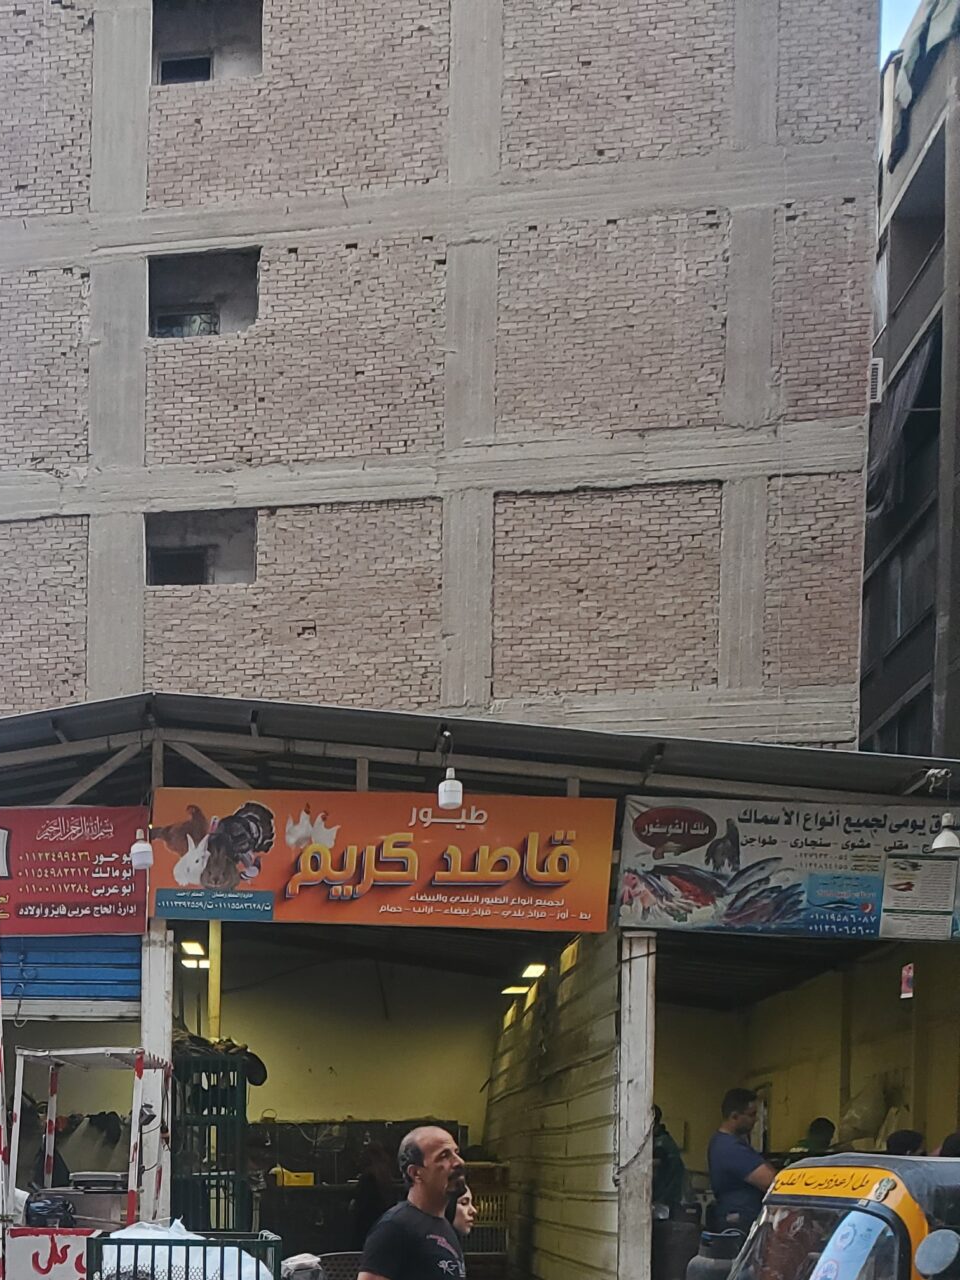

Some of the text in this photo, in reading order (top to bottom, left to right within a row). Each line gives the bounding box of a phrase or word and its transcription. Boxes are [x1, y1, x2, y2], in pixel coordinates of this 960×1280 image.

[408, 806, 489, 829] طيور
[802, 809, 840, 831] أنواع
[642, 819, 709, 836] ملك الفوسفور
[843, 813, 888, 834] لجميع
[740, 835, 778, 848] طواجن
[92, 853, 120, 864] حور
[121, 853, 133, 865] بو
[286, 830, 580, 899] قاصد كريم
[481, 895, 508, 906] الطيور
[535, 898, 565, 908] لجميع
[93, 904, 115, 917] الحاج
[379, 903, 402, 913] حمام
[443, 906, 470, 917] بيضاء
[471, 906, 491, 917] فراخ
[528, 909, 547, 919] فراخ
[579, 911, 591, 920] بط
